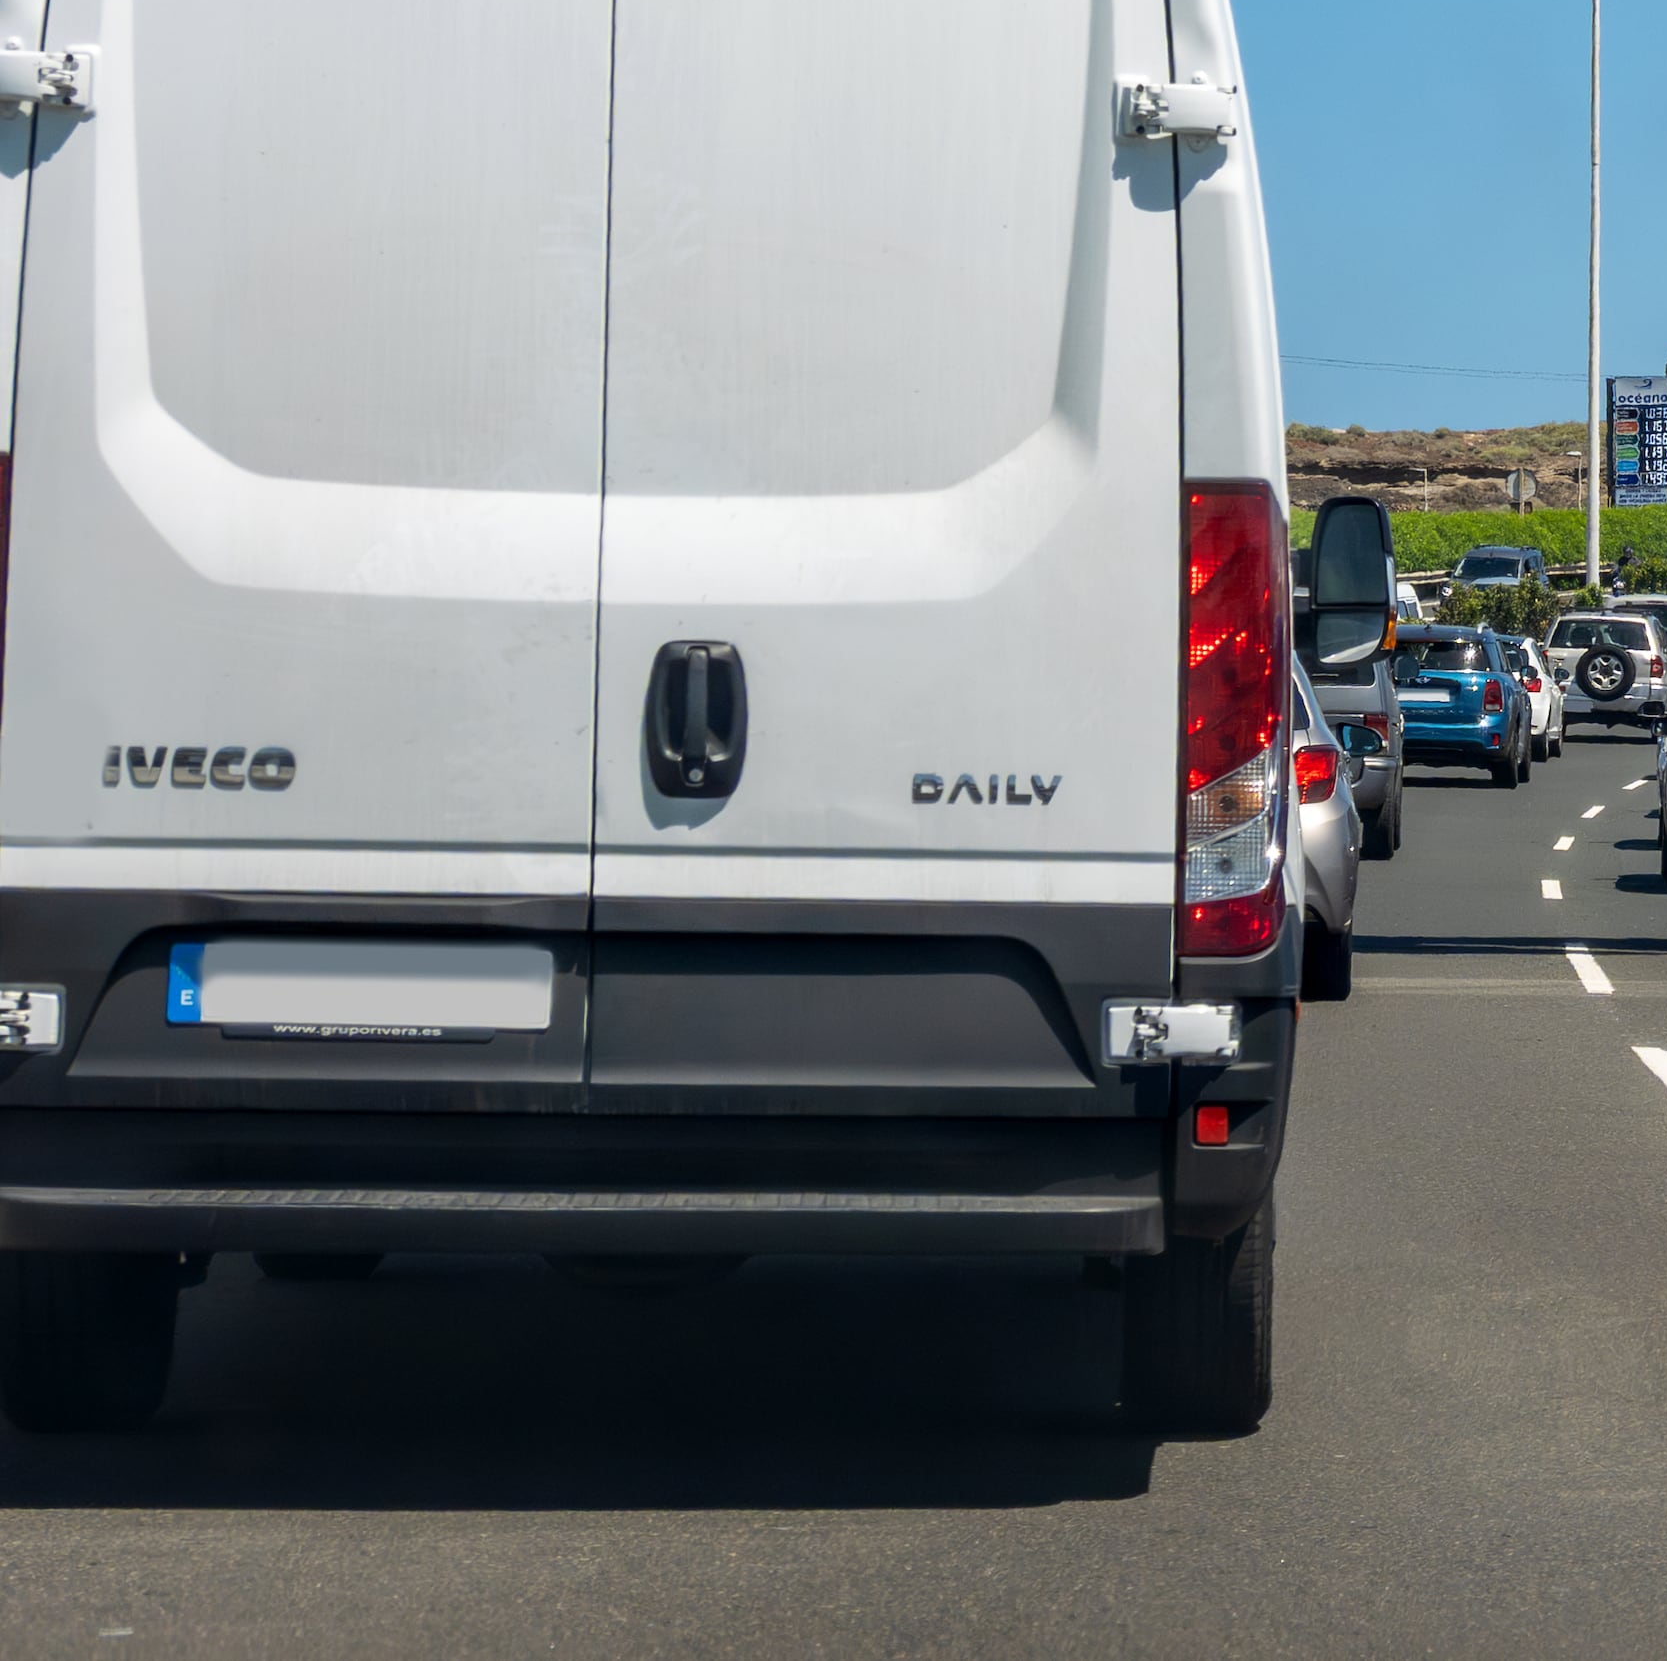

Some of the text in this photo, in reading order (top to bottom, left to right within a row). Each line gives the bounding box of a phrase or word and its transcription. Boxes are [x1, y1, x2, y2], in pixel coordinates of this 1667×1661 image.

[101, 744, 297, 791] IVECO
[911, 771, 1063, 806] DAILY
[180, 989, 194, 1006] E
[273, 1022, 442, 1037] www.gruporivera.es
